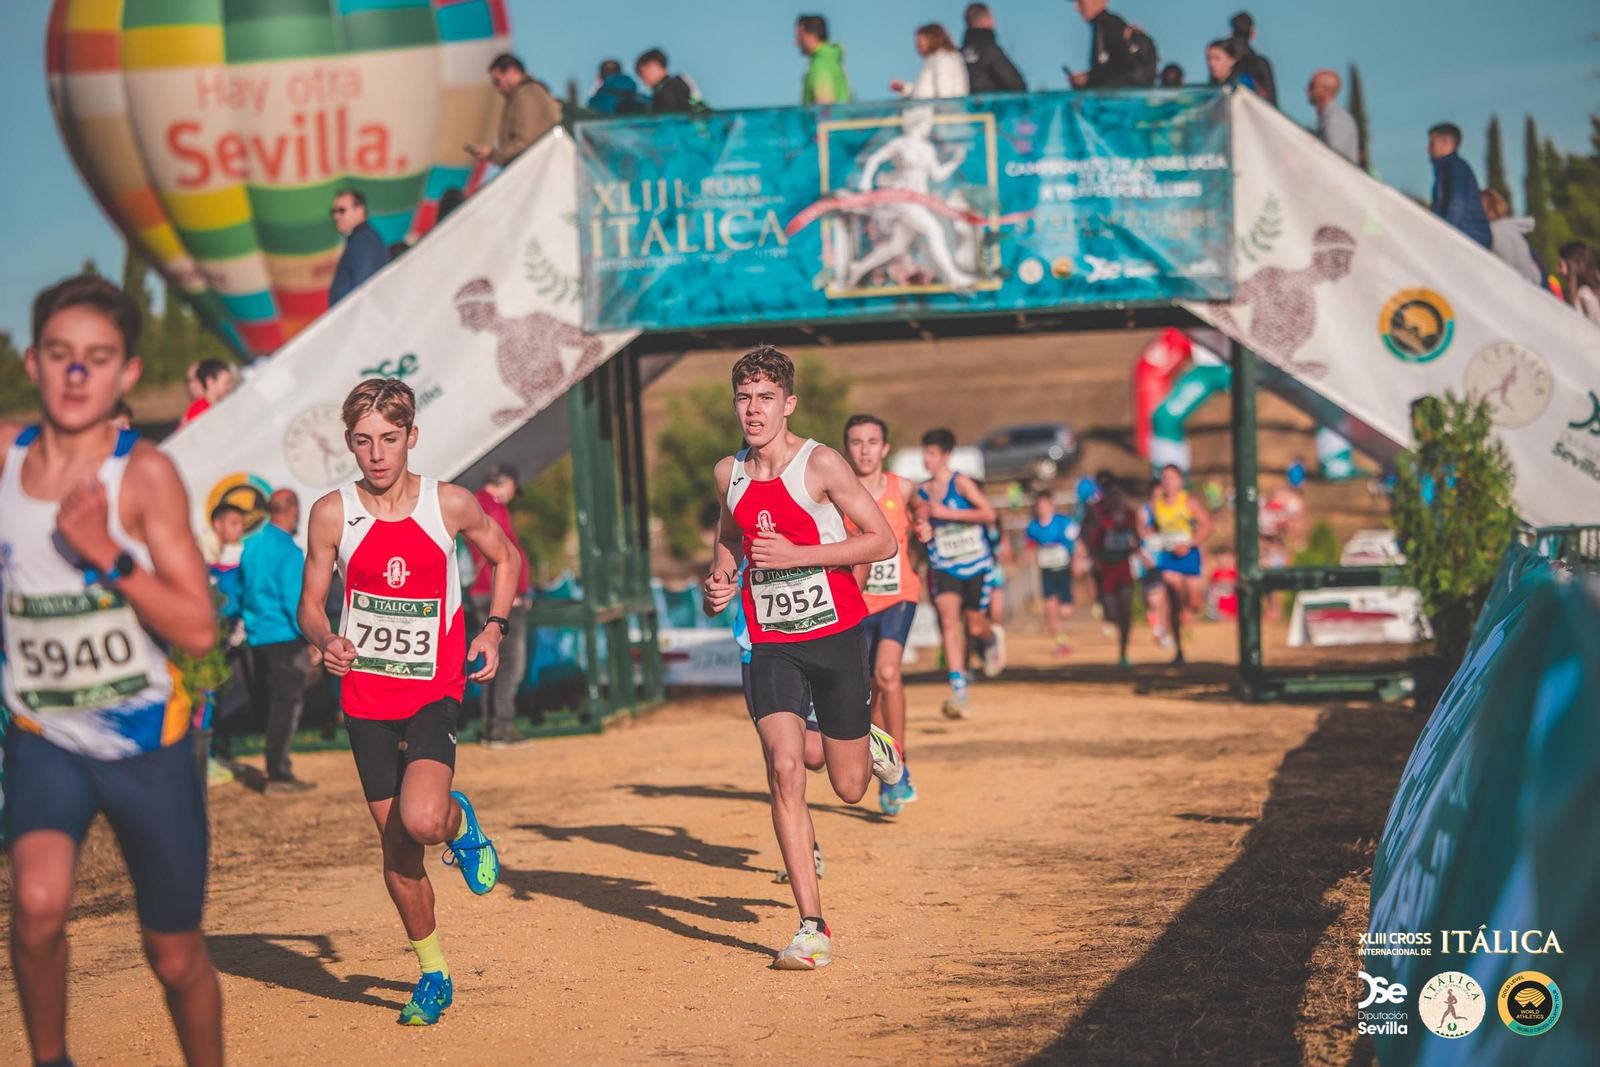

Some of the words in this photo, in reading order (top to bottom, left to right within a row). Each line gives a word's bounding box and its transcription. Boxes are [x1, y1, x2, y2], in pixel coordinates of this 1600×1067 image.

[195, 68, 270, 118] Hay
[287, 66, 363, 106] otra
[165, 105, 409, 189] Sevilla.
[868, 564, 896, 581] 82
[761, 585, 828, 617] 7952
[20, 630, 132, 678] 5940
[356, 622, 431, 657] 7953
